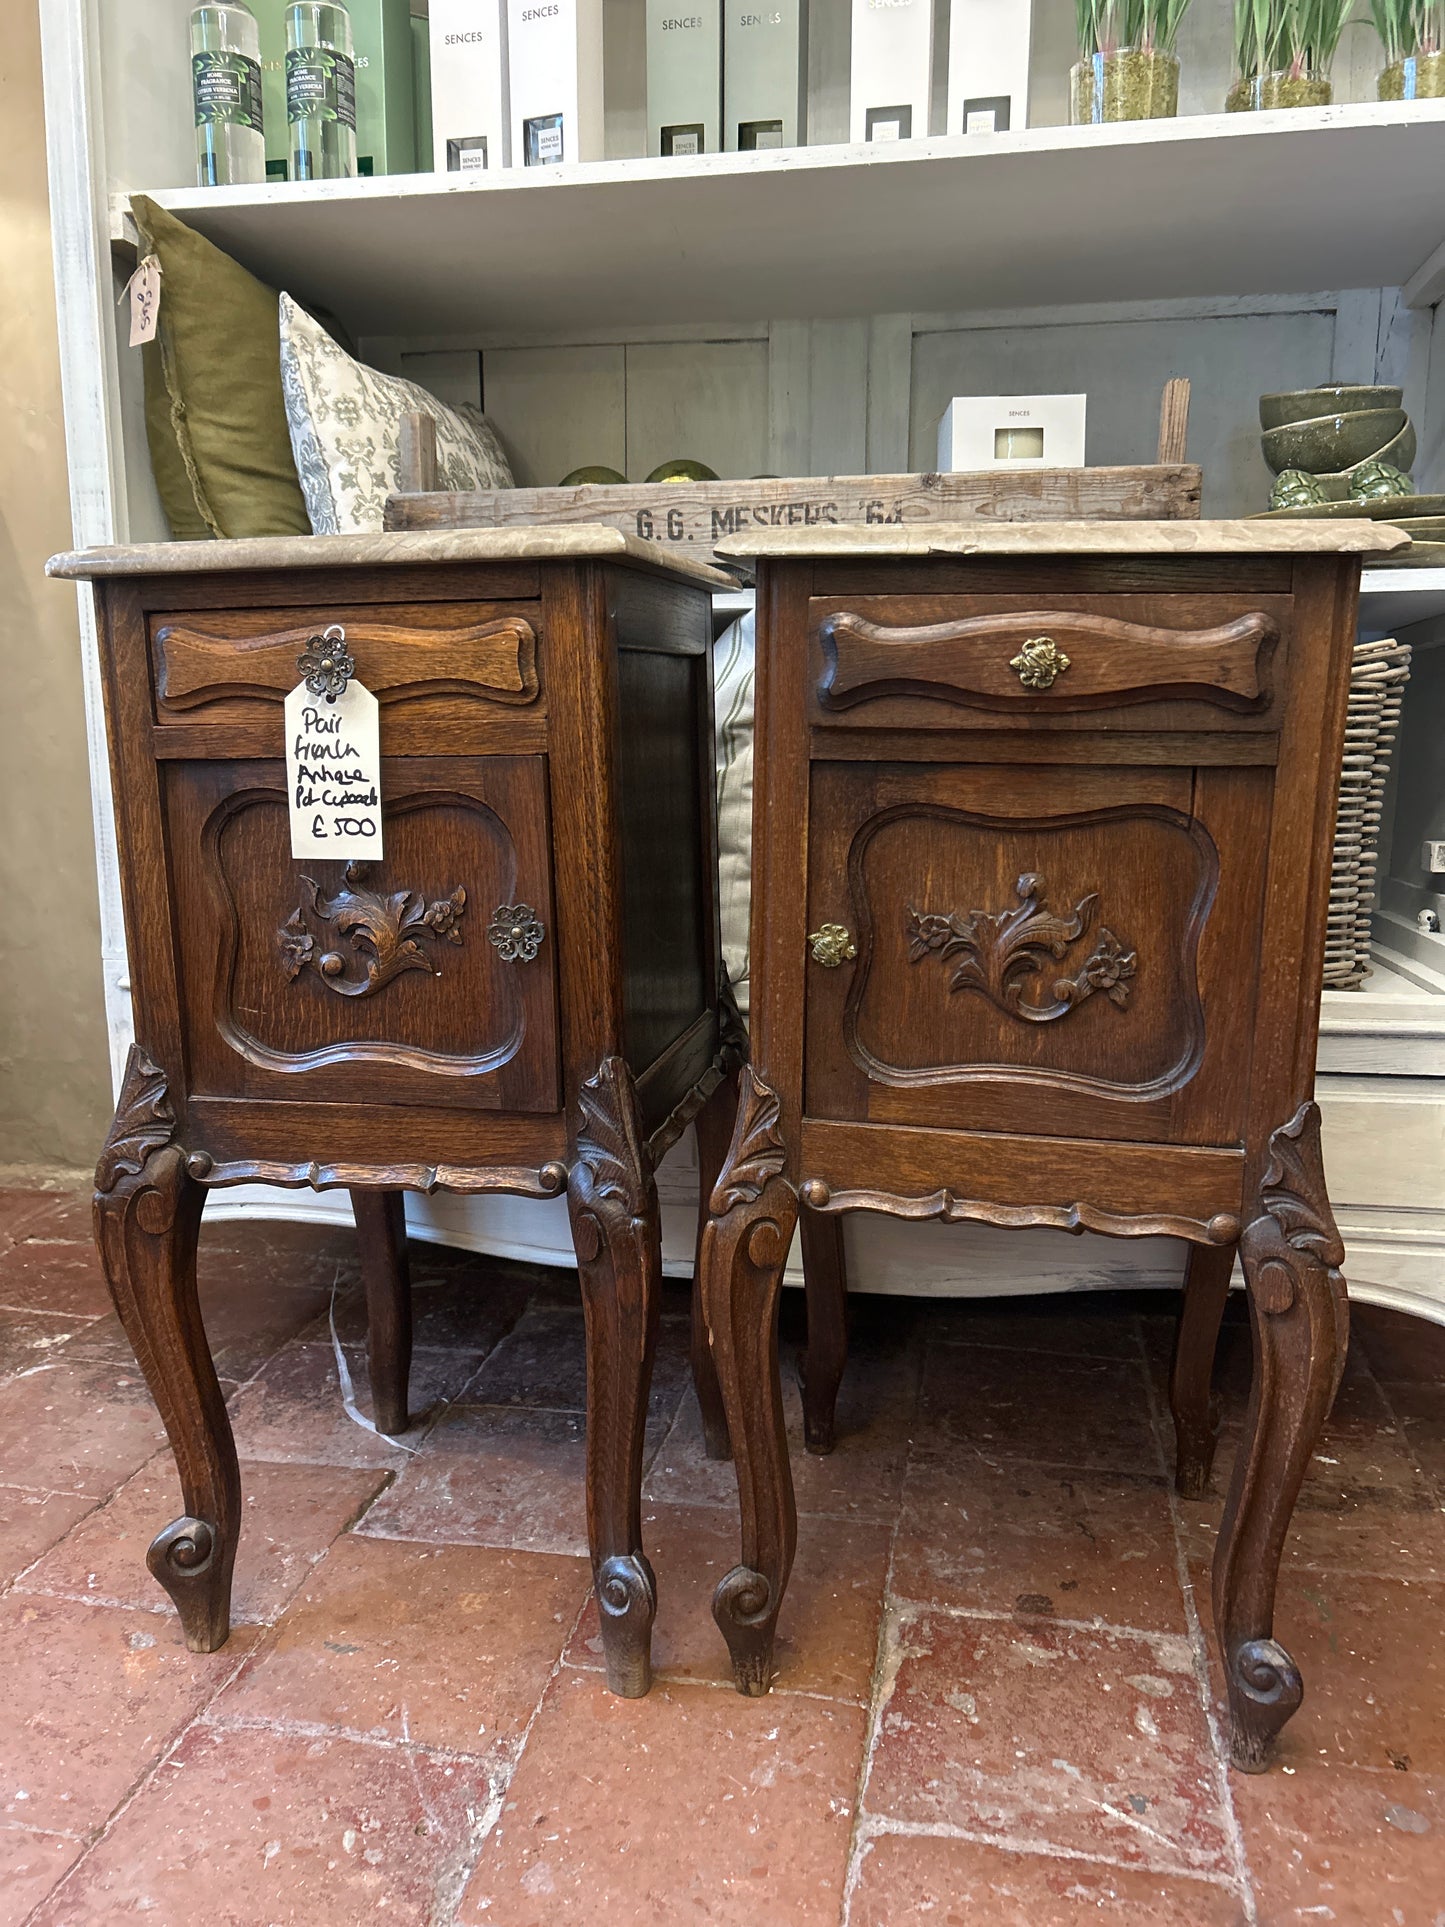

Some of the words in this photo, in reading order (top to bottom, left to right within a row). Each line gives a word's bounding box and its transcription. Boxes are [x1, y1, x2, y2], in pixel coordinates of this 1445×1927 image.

[522, 5, 559, 21] SENCES
[662, 17, 702, 30] SENCES
[444, 32, 483, 45] SENCES
[200, 78, 232, 86] FRAGRANCE
[636, 508, 694, 541] G.G.
[711, 502, 838, 538] MESKERS
[301, 707, 342, 734] Pair
[297, 764, 370, 785] Antique
